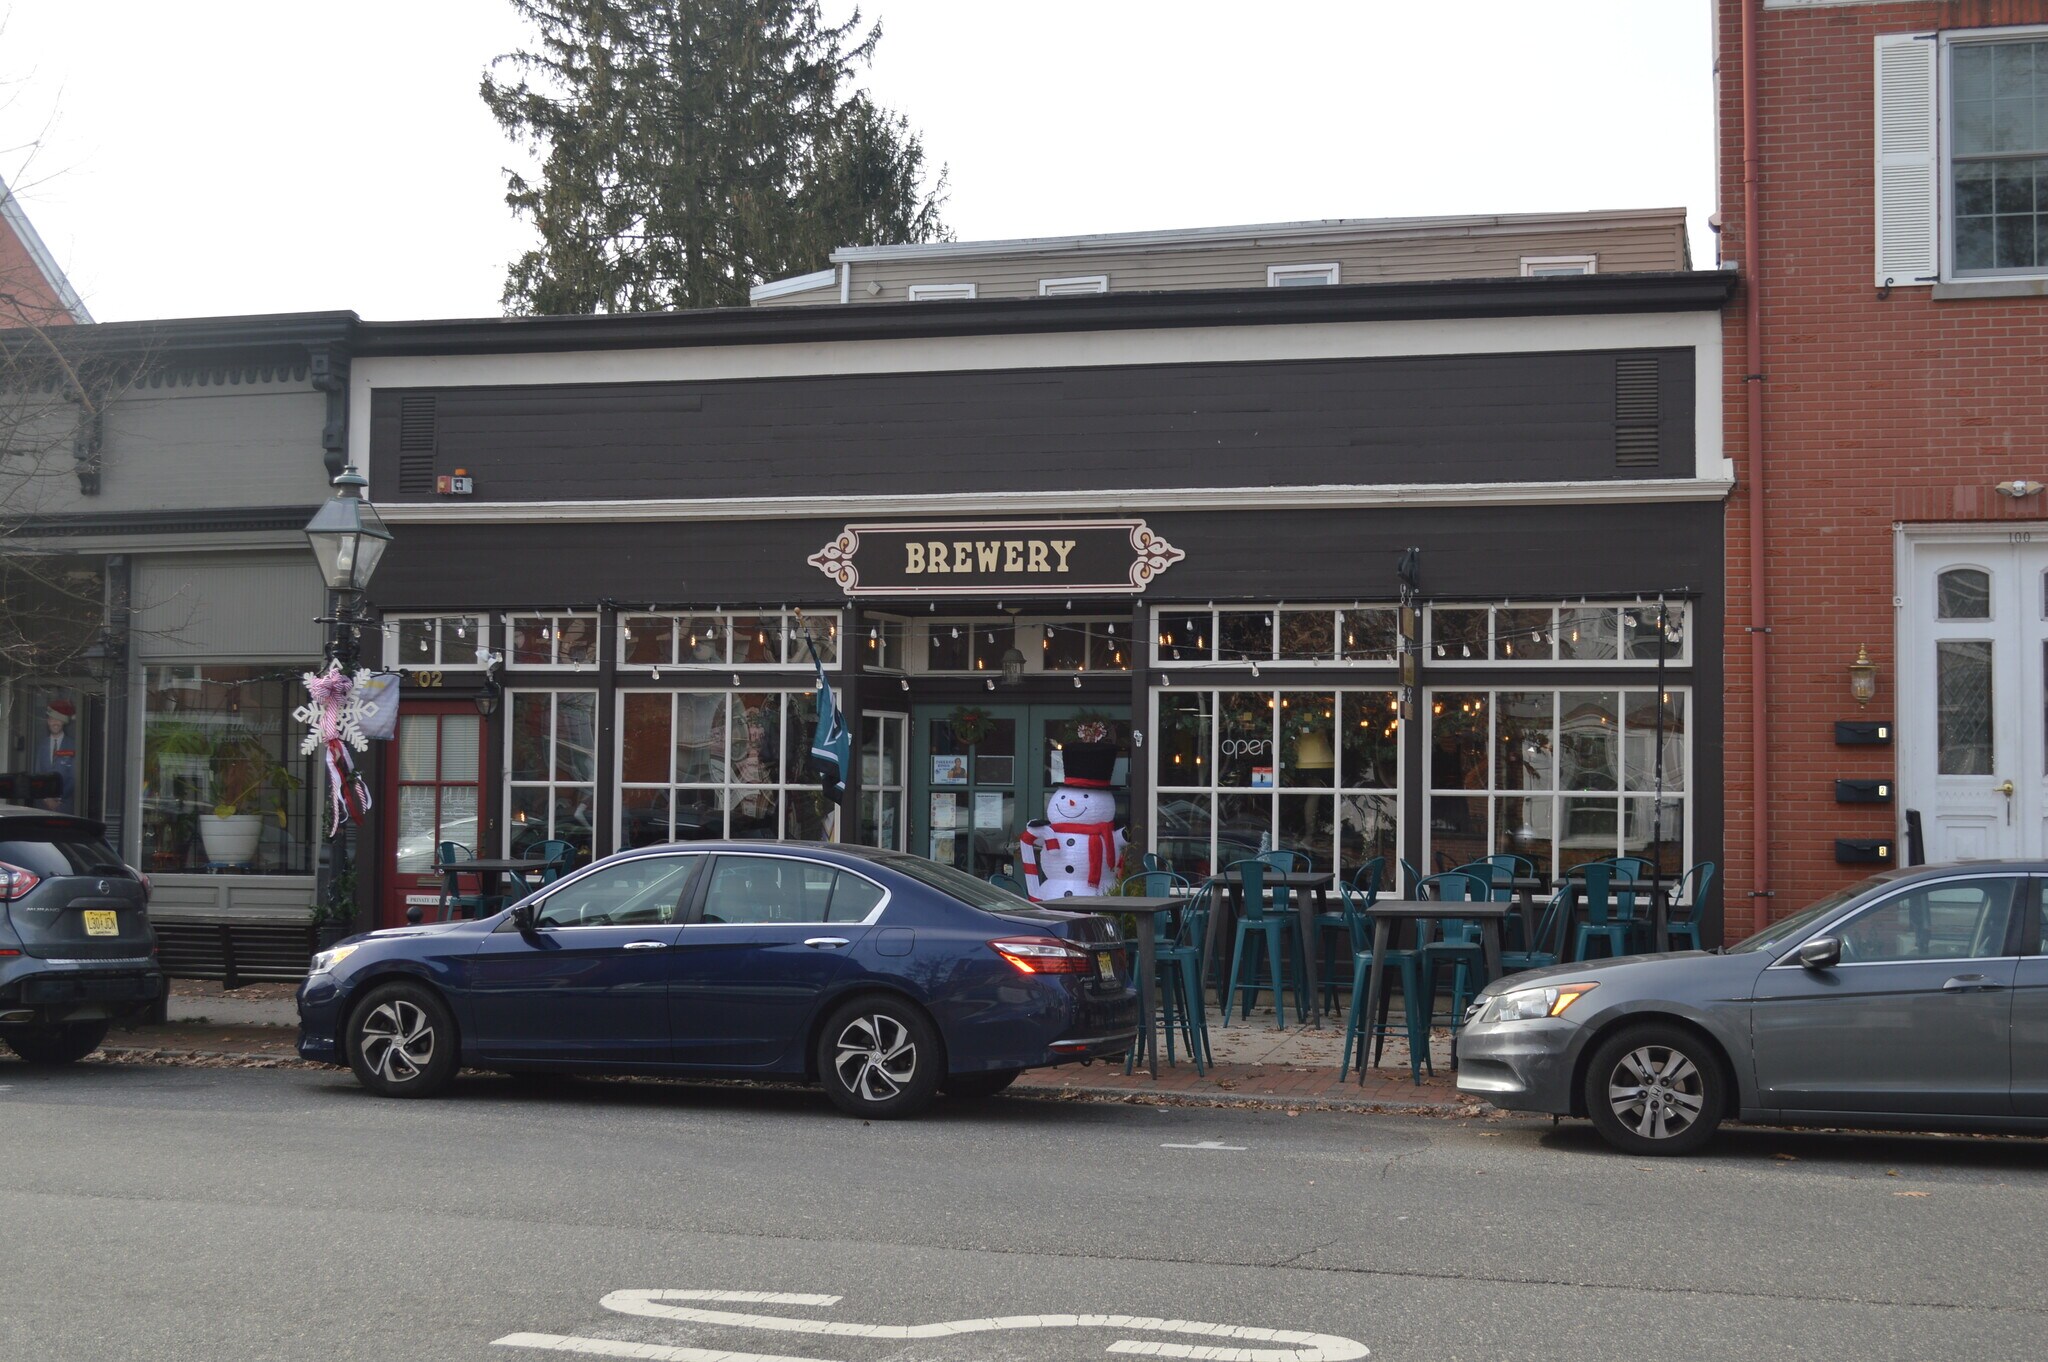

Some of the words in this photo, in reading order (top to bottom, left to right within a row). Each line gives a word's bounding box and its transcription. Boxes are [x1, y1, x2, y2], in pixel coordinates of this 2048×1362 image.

[2009, 531, 2031, 544] 100
[905, 540, 1076, 574] BREWERY
[1221, 739, 1273, 760] open
